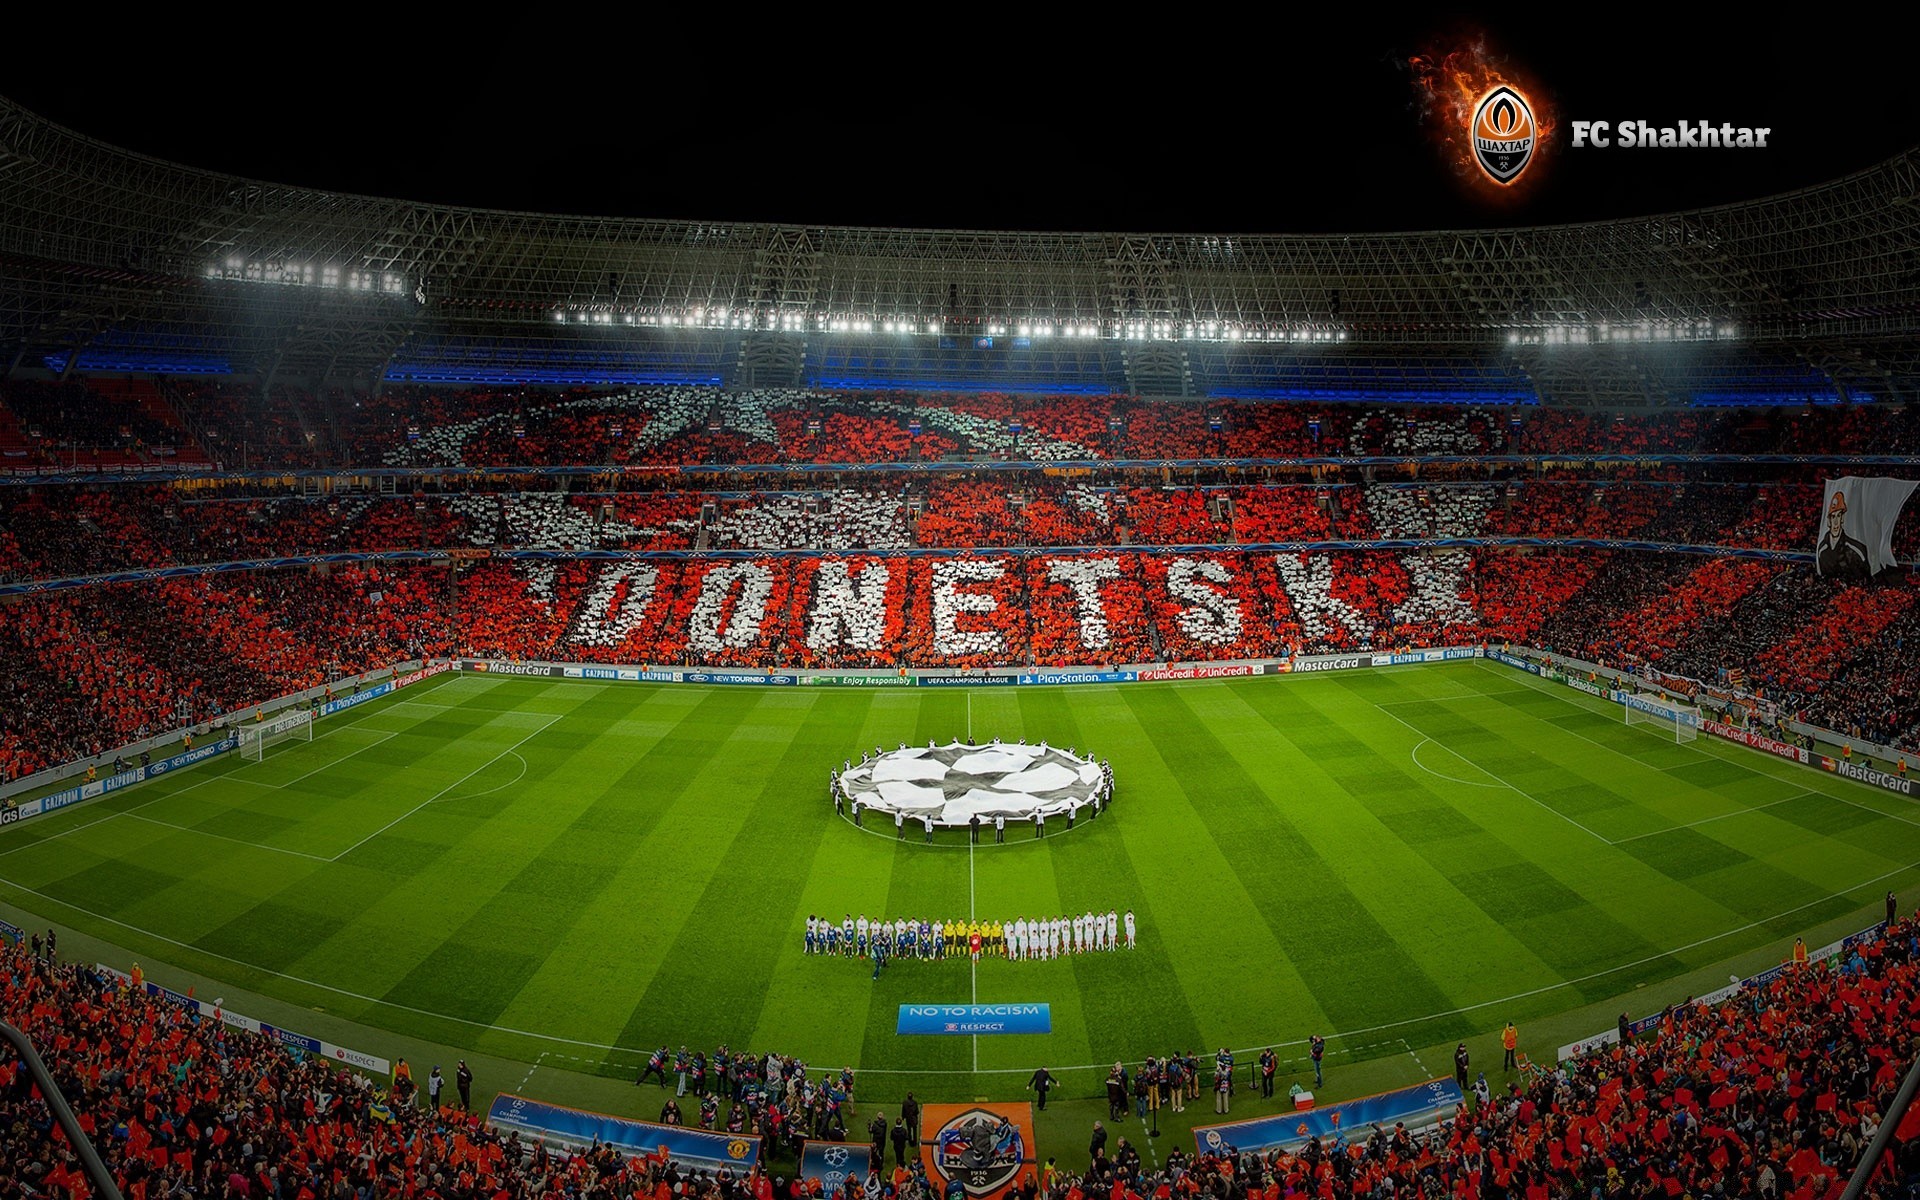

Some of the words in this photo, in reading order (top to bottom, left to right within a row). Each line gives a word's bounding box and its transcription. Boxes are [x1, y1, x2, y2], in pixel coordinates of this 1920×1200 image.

[570, 553, 1375, 654] DONETSK
[1394, 653, 1422, 664] GAZPROM
[1446, 649, 1474, 659] GAZPROM
[489, 661, 550, 676] MasterCard
[1207, 666, 1248, 677] UniCredit
[1294, 657, 1359, 672] MasterCard
[585, 669, 615, 679] GAZPROM
[642, 672, 671, 681] GAZPROM
[843, 676, 864, 686] Enjoy
[866, 676, 911, 686] Responsibly
[1154, 669, 1195, 680] UniCredit
[1568, 675, 1600, 696] Heineken
[1715, 723, 1748, 744] UniCredit
[1759, 738, 1795, 759] UniCredit
[171, 756, 186, 768] NEW
[186, 746, 215, 763] TOURNEO
[107, 770, 136, 790] GAZPROM
[1838, 760, 1911, 794] MasterCard
[46, 789, 78, 810] GAZPROM
[0, 810, 18, 824] as
[165, 992, 189, 1006] RESPECT
[1705, 990, 1730, 1004] RESPECT
[910, 1007, 938, 1016] NO
[942, 1007, 966, 1016] TO
[971, 1006, 1039, 1016] RACISM
[222, 1012, 247, 1026] RESPECT
[281, 1032, 310, 1047] RESPECT
[346, 1052, 375, 1067] RESPECT
